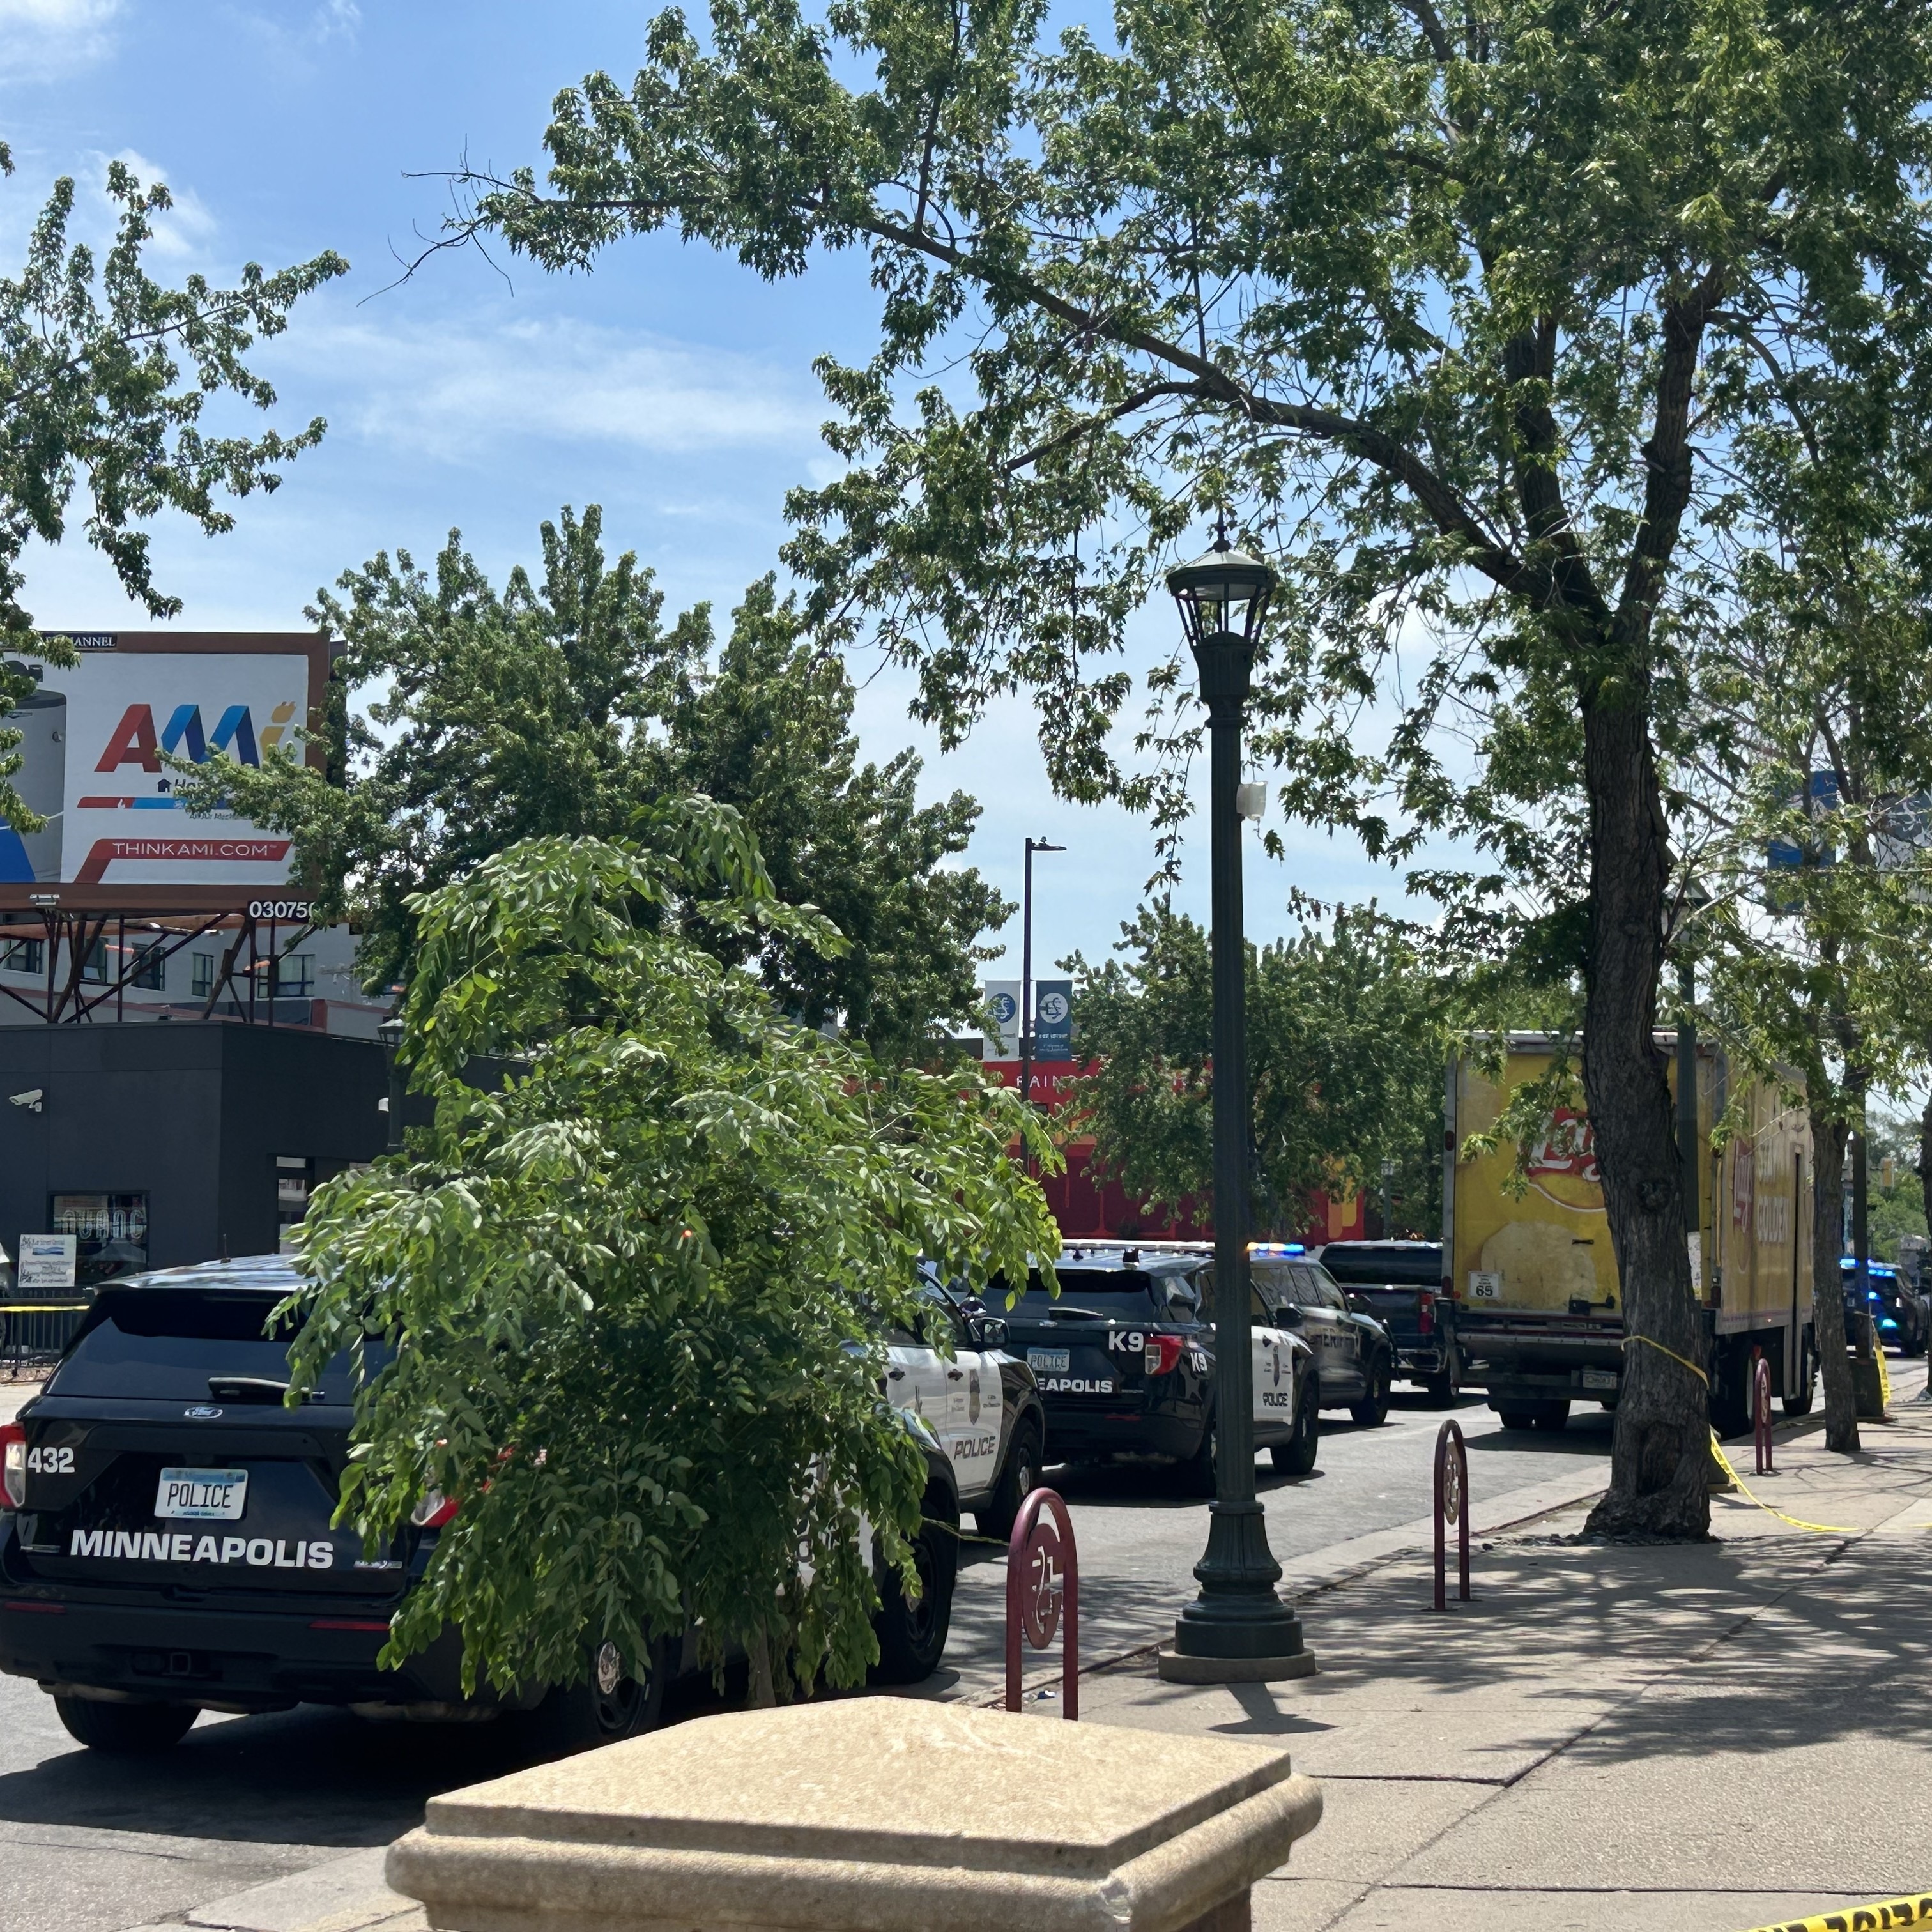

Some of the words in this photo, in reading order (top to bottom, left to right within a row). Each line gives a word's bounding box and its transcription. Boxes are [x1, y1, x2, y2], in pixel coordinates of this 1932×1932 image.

[71, 636, 116, 647] ANNEL
[249, 901, 314, 919] 03075
[1108, 1331, 1144, 1352] K9
[1031, 1354, 1066, 1369] POLICE
[1190, 1352, 1208, 1372] K9
[1038, 1378, 1113, 1393] EAPOLIS
[1262, 1392, 1288, 1407] POLICE
[954, 1436, 996, 1460] POLICE
[27, 1447, 75, 1473] 432
[167, 1482, 234, 1508] POLICE
[70, 1529, 334, 1569] MINNEAPOLIS
